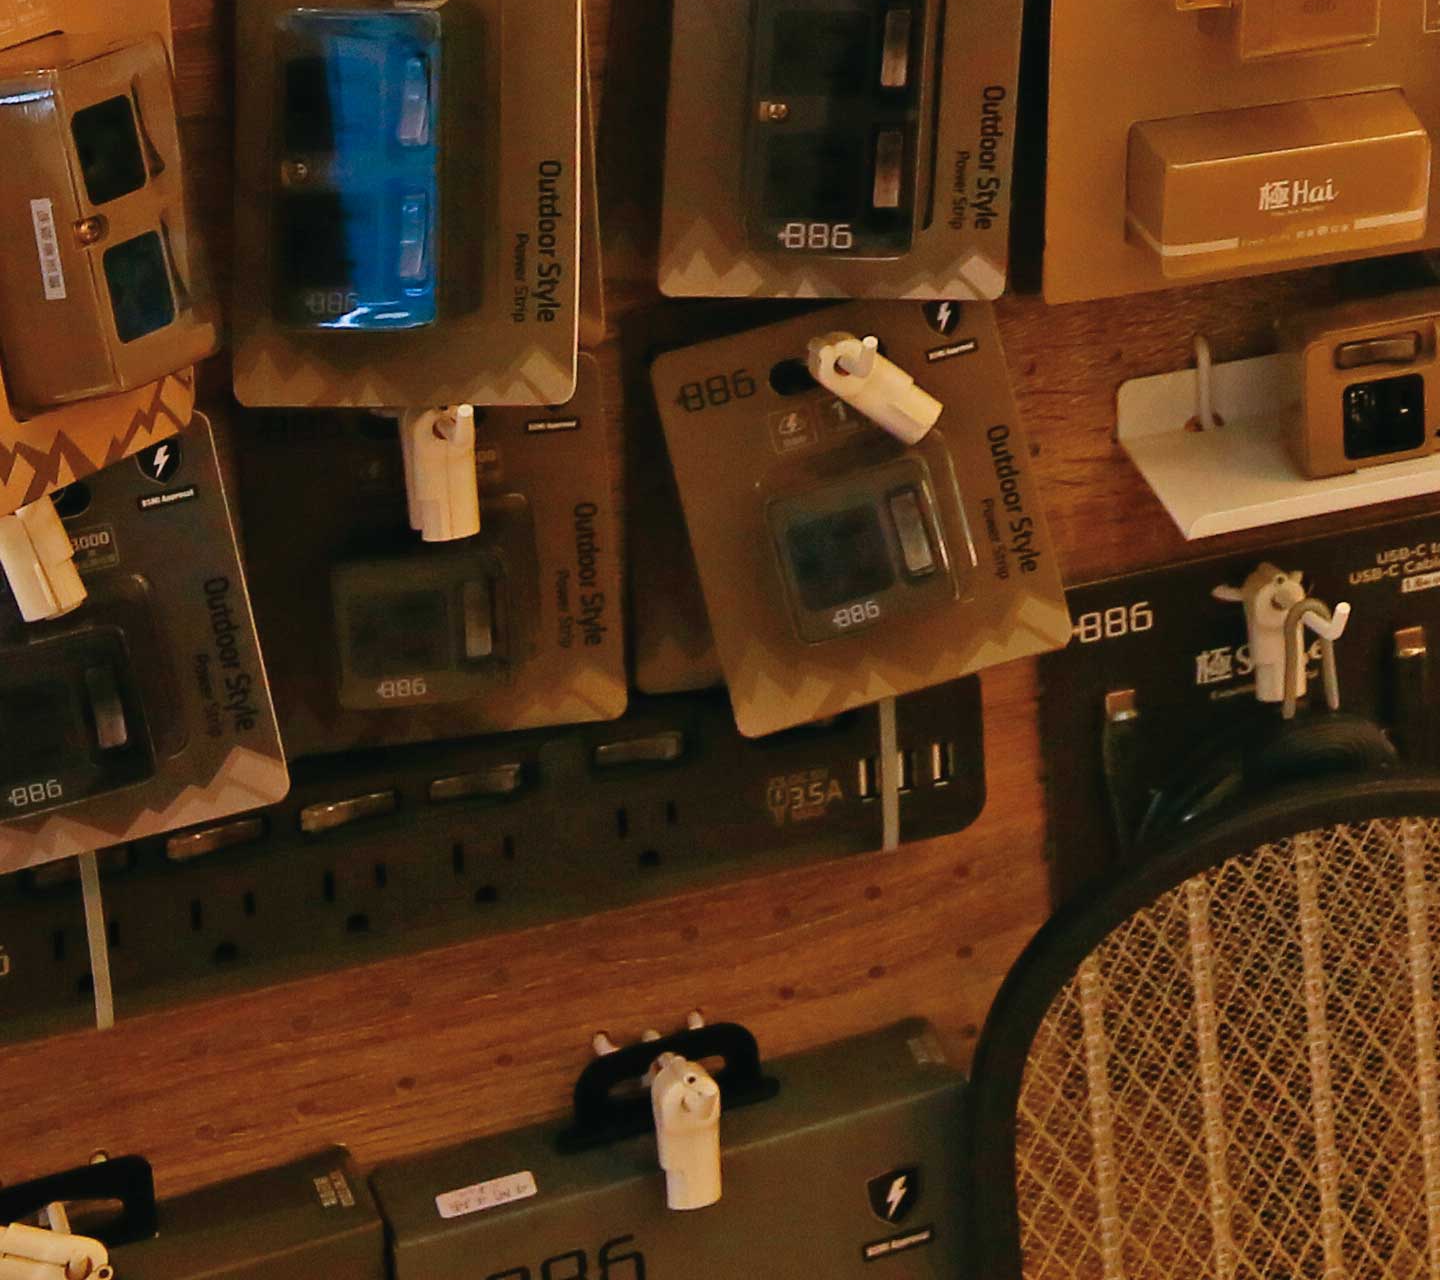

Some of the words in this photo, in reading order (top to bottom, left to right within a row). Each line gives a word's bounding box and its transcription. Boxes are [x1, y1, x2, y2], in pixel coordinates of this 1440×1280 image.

[983, 86, 1005, 172] Outdoor
[958, 151, 969, 196] Power
[538, 160, 562, 254] Outdoor
[952, 198, 967, 230] Strip
[975, 178, 1001, 230] Style
[514, 232, 530, 276] Power
[514, 280, 526, 323] Strip
[536, 259, 561, 323] Style
[986, 424, 1022, 513] Outdoor
[1010, 515, 1039, 573] Style
[573, 502, 601, 588] Outdoor
[580, 590, 607, 647] Style
[203, 575, 238, 669] Outdoor
[223, 671, 257, 733] Style
